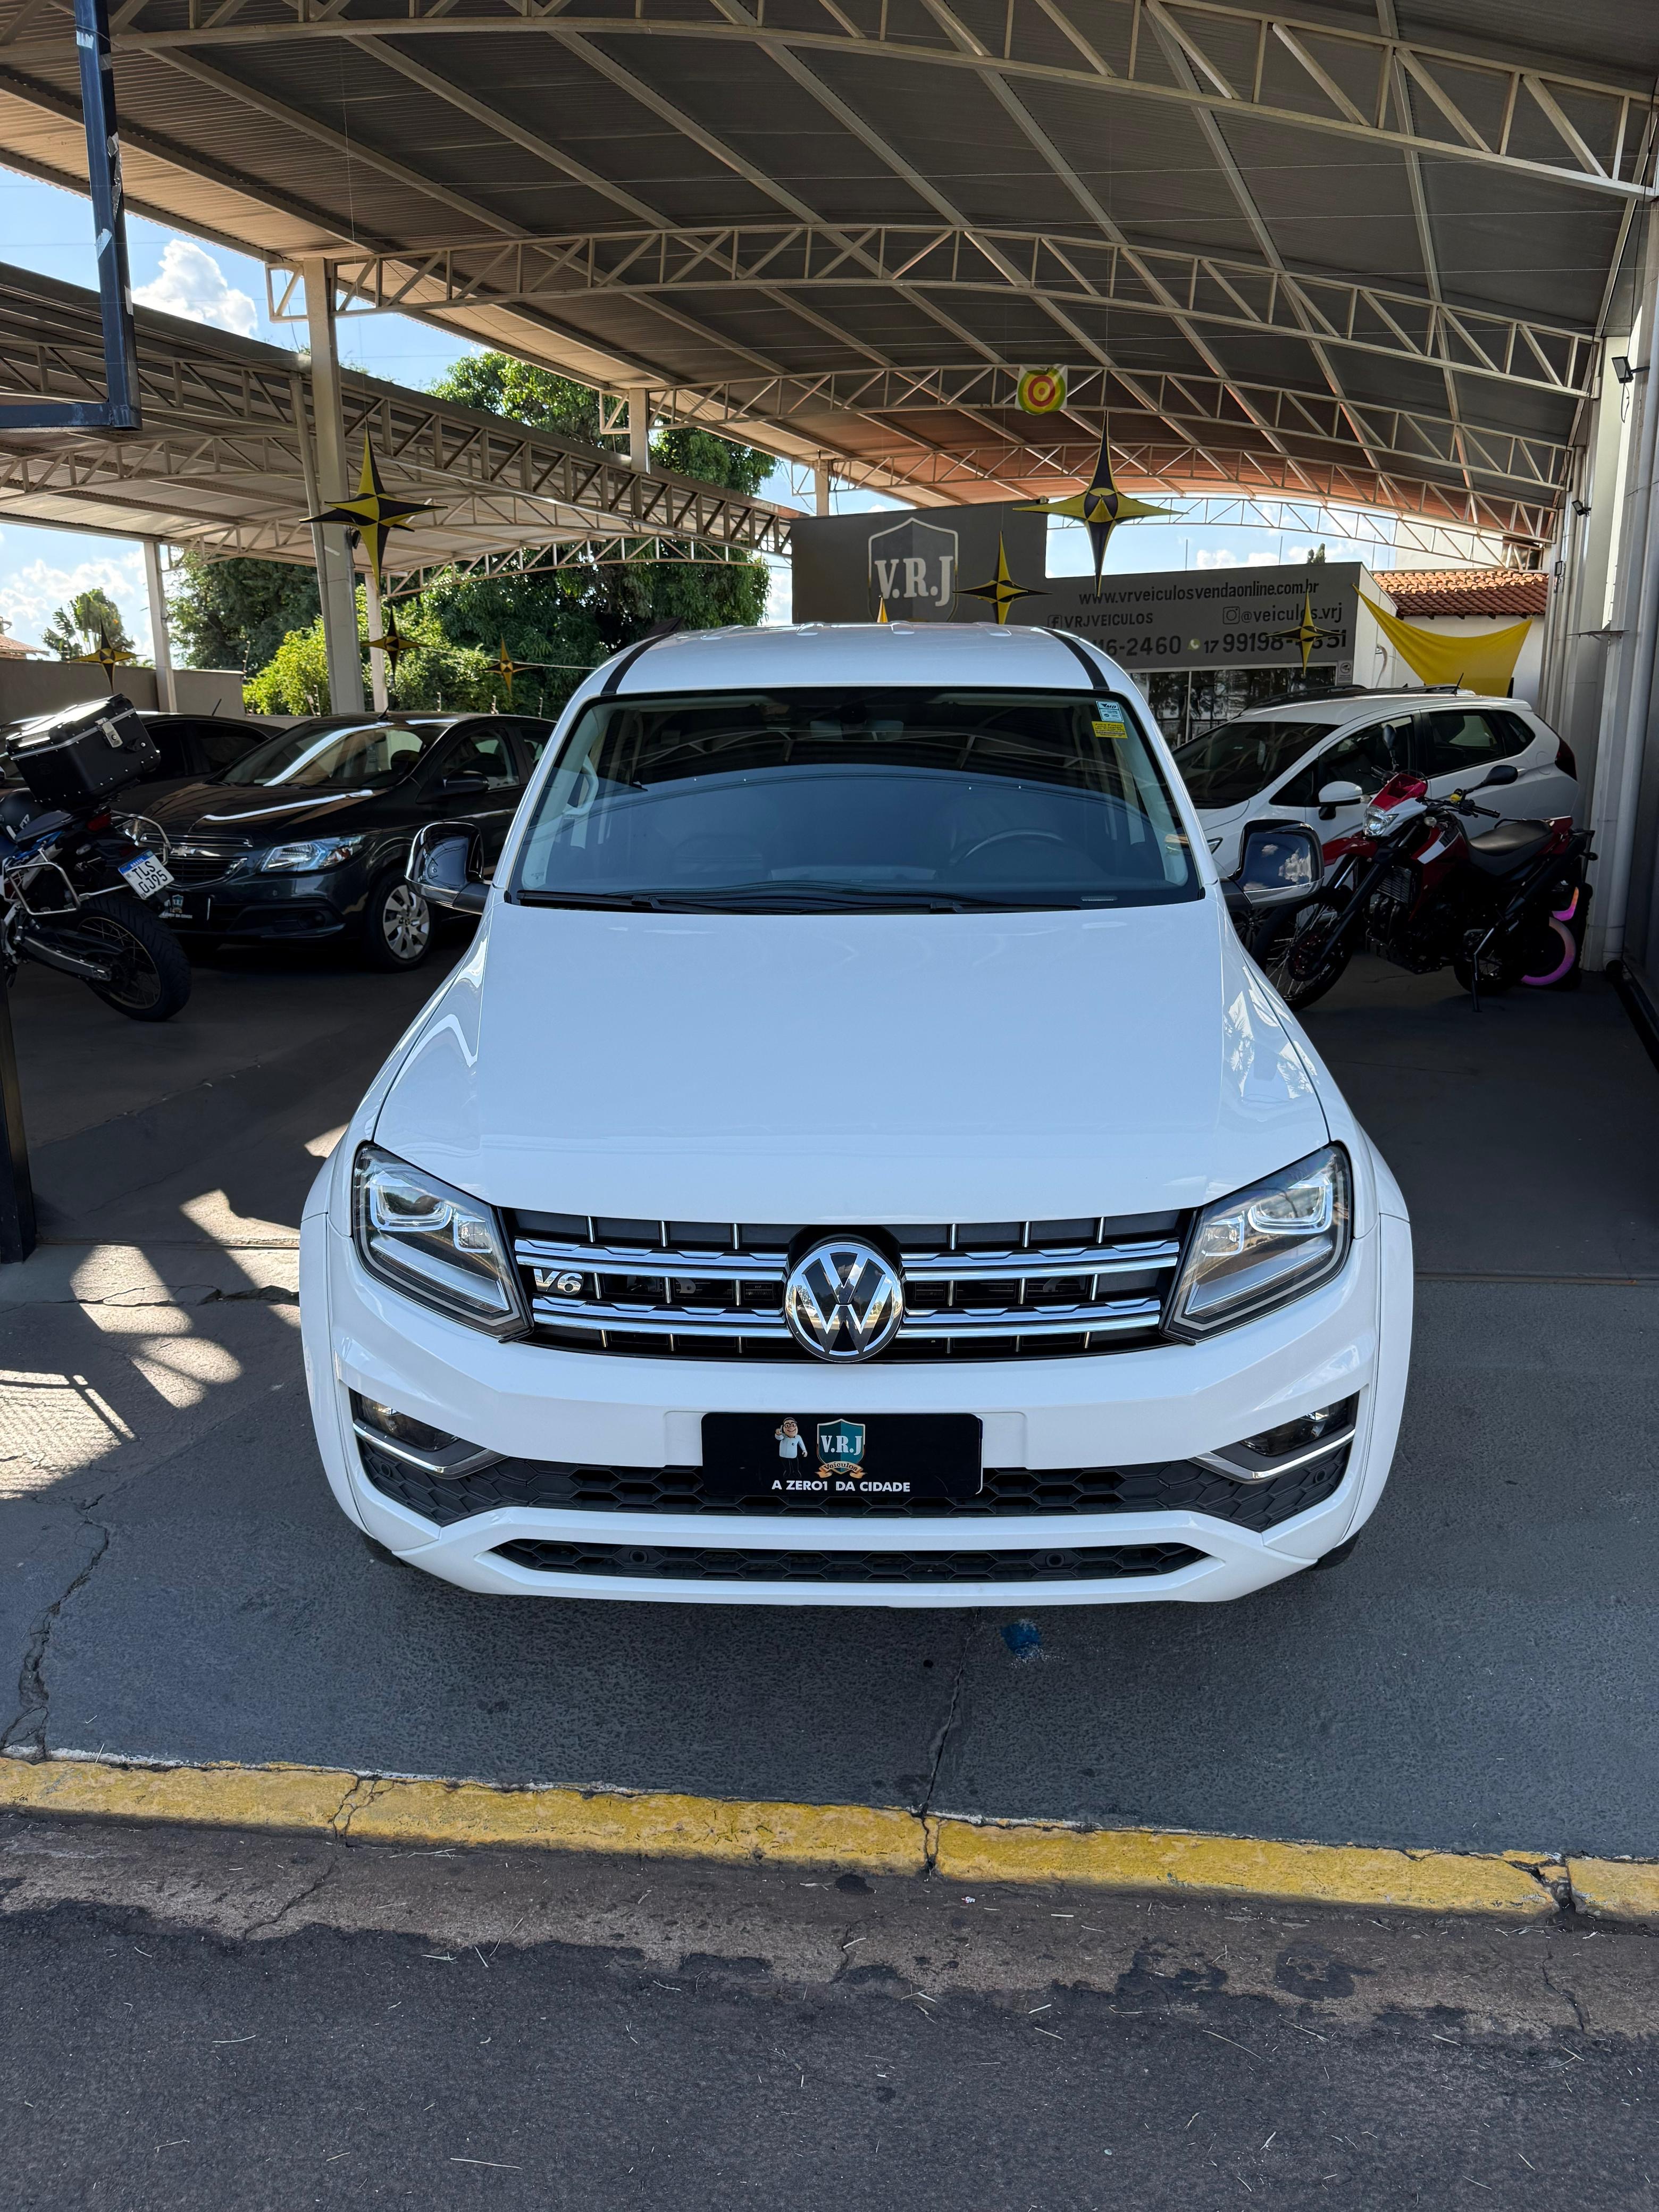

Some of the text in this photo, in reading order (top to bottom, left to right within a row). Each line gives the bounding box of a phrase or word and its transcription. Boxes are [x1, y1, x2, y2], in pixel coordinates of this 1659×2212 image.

[874, 556, 953, 607] V.R.J
[1079, 578, 1319, 605] www.vrveiculosvendaonline.com.br
[1241, 602, 1342, 623] @veiculs_vrj
[1203, 640, 1219, 654] 17
[131, 860, 156, 880] TLS
[533, 1268, 583, 1296] V6
[820, 1435, 862, 1455] V.R.J
[772, 1480, 782, 1490] A
[835, 1481, 856, 1491] DA
[859, 1481, 910, 1492] CIDADE
